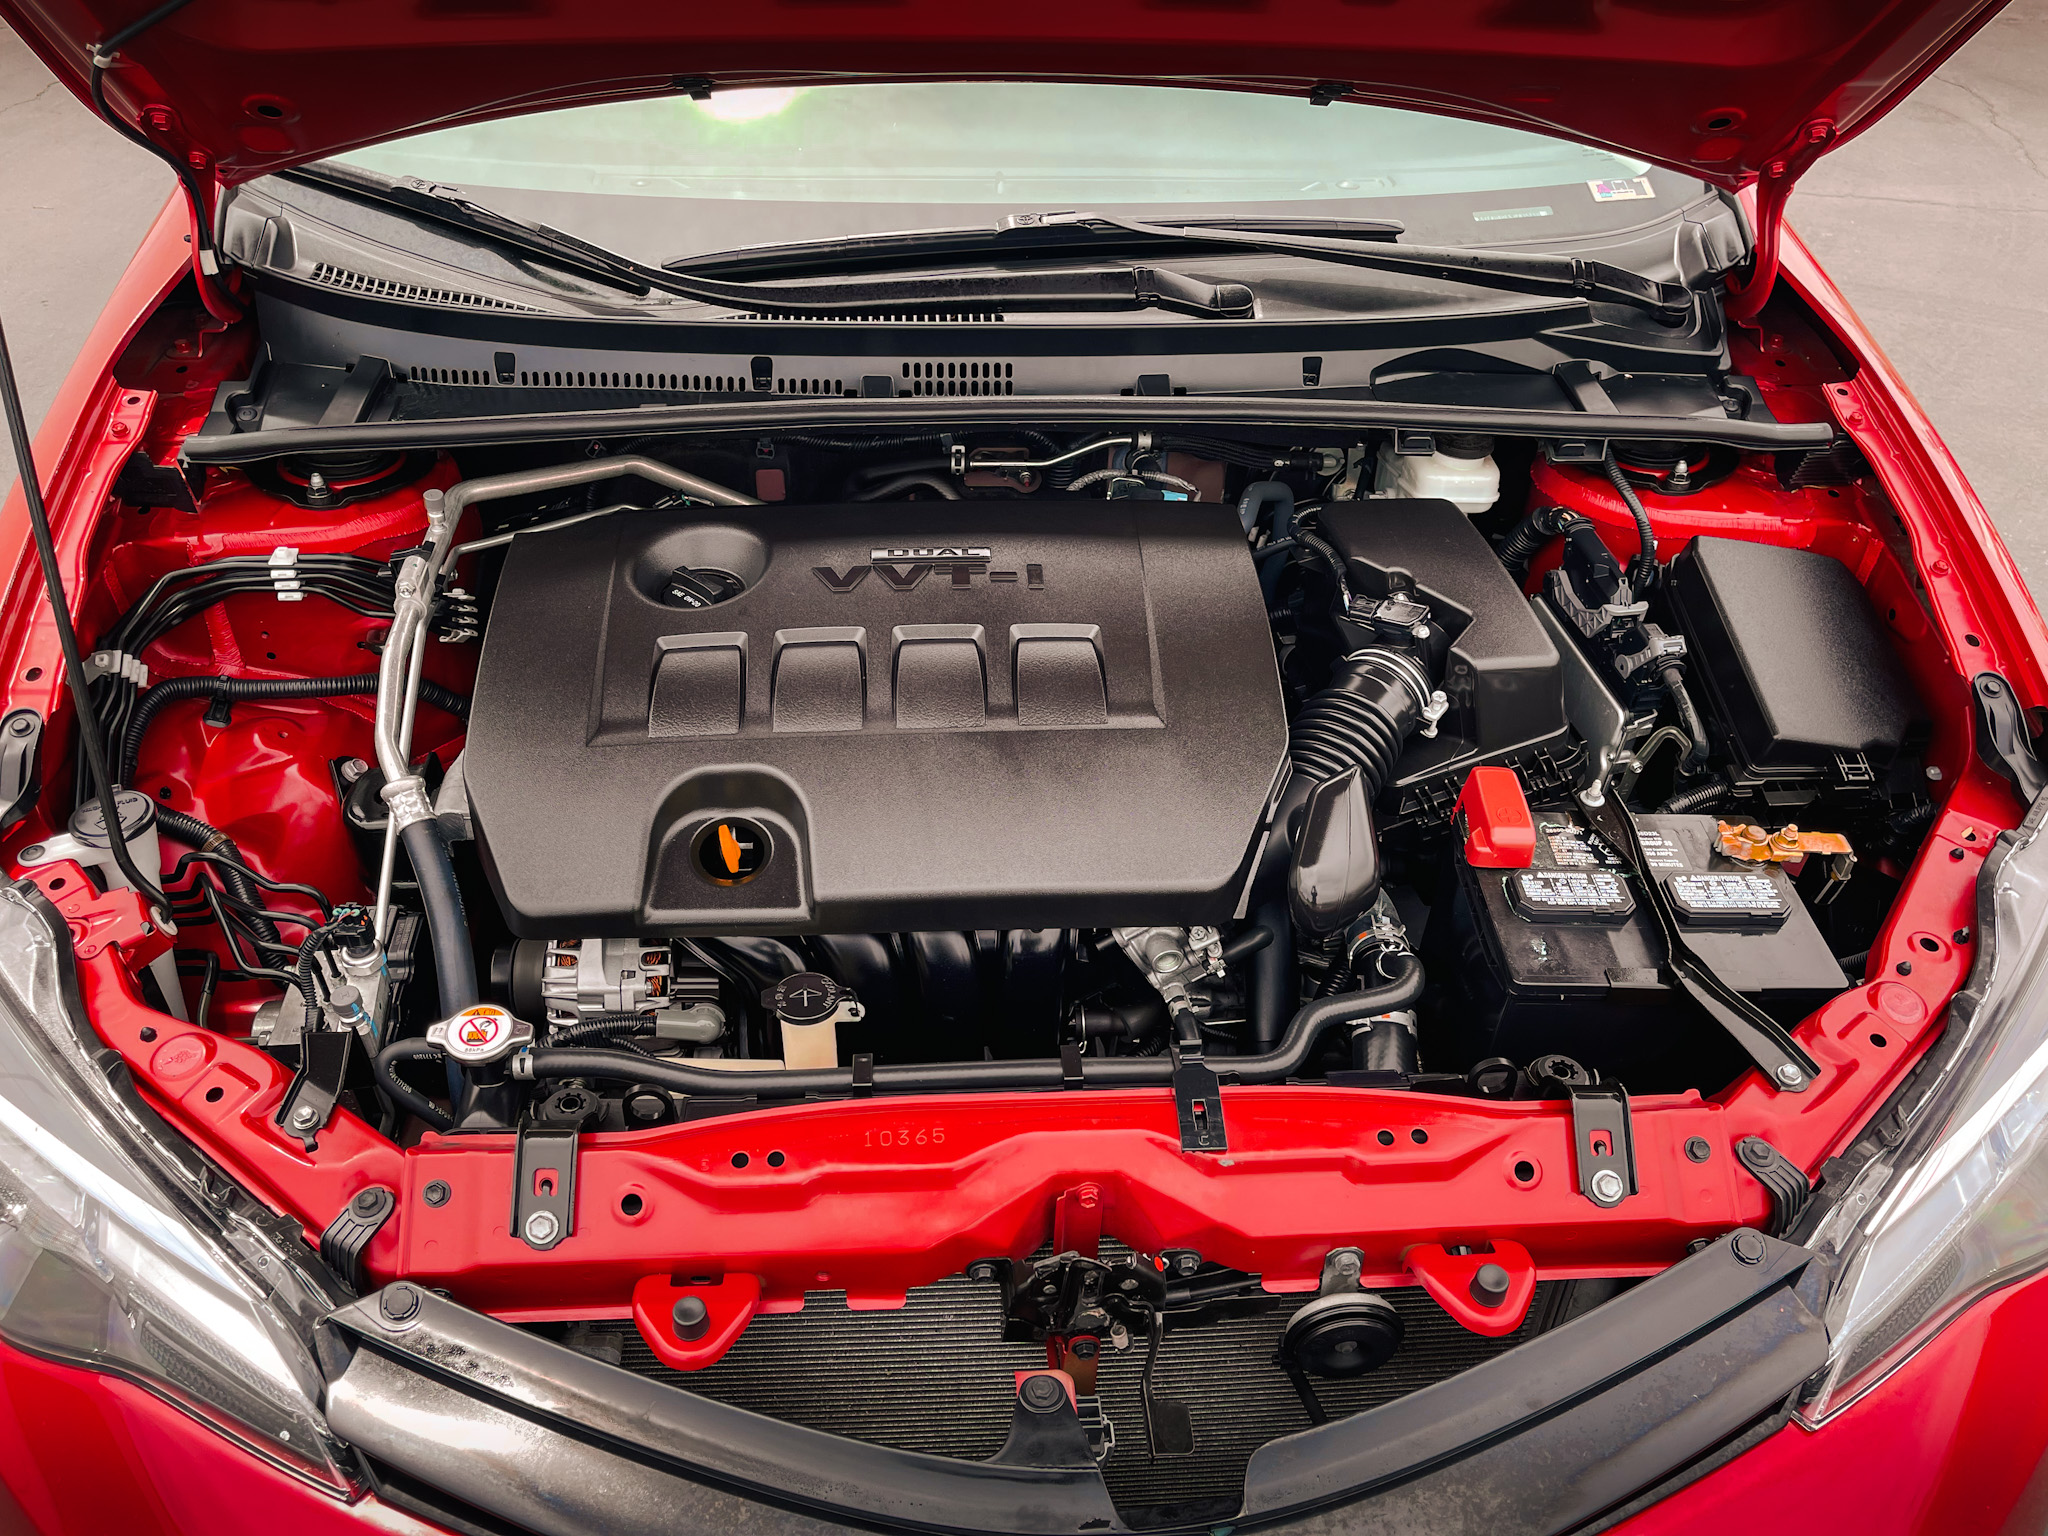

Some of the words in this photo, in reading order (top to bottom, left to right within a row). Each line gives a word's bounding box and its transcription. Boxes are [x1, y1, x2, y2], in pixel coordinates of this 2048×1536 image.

[887, 548, 981, 557] DUAL
[671, 589, 685, 598] SAE
[864, 1127, 945, 1147] 10365
